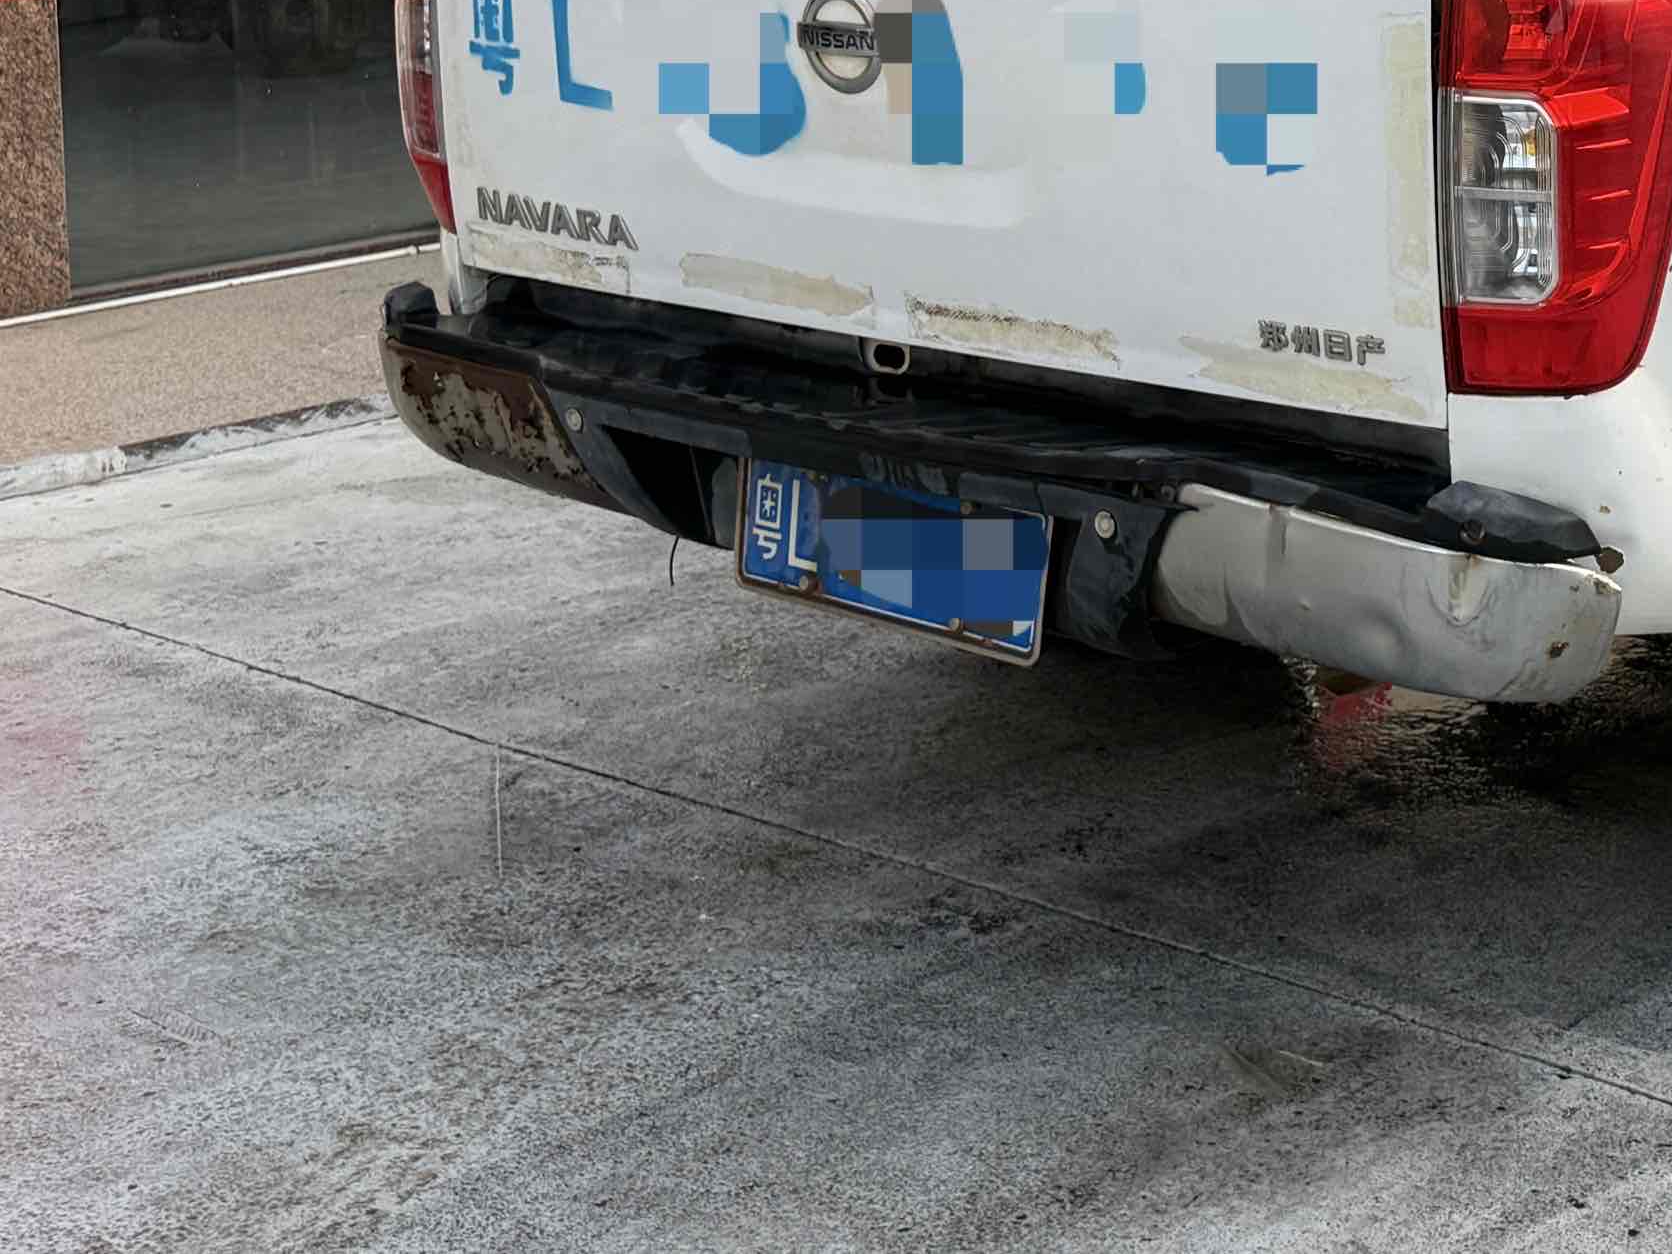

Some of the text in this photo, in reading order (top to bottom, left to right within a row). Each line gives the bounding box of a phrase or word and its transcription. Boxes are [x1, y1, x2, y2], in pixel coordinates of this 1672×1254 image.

[800, 25, 875, 51] NISSAN
[476, 187, 640, 251] NAVARA
[1257, 318, 1386, 367] 郑州日产
